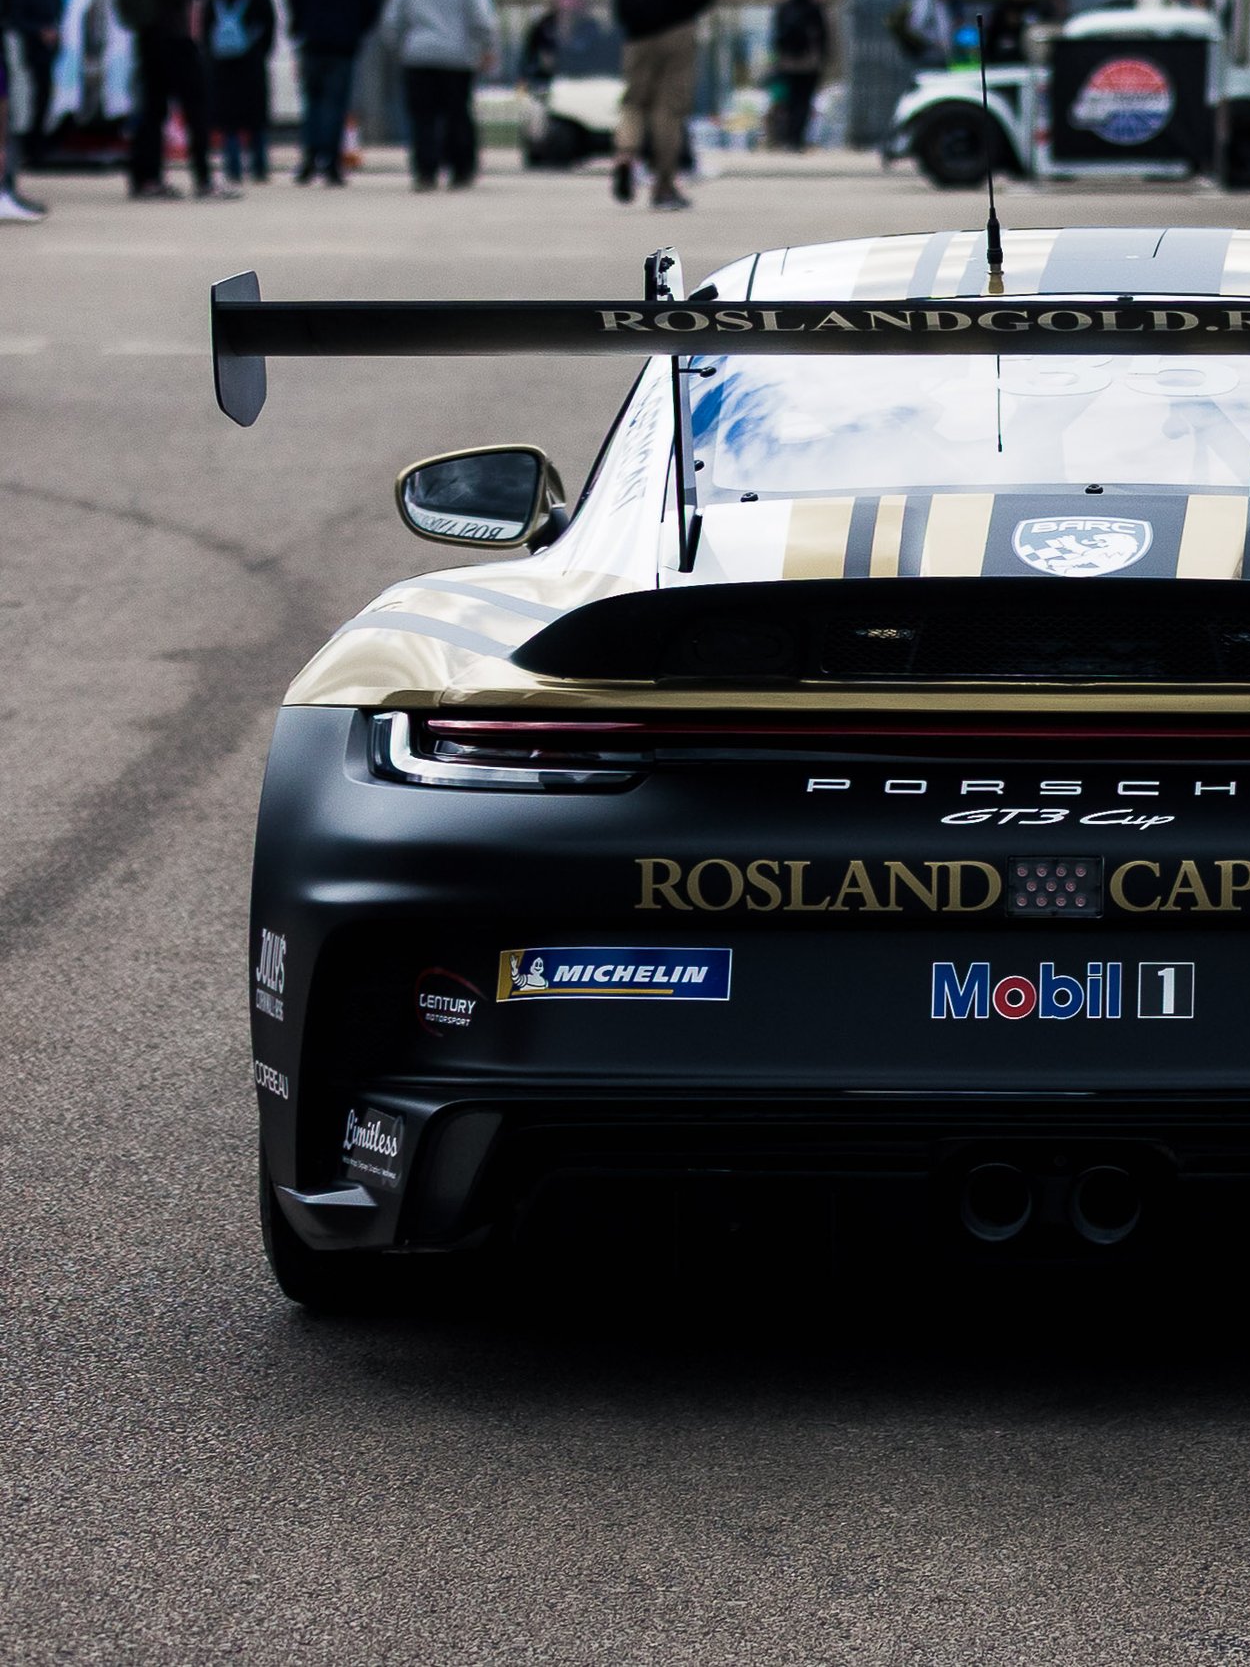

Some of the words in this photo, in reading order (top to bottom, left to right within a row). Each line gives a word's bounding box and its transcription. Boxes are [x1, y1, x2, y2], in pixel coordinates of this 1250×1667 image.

[1031, 520, 1137, 533] BARC
[941, 808, 1070, 825] GT3
[1080, 809, 1175, 830] Cup
[634, 858, 1001, 912] ROSLAND
[553, 964, 709, 983] MICHELIN
[931, 962, 1122, 1019] Mobil
[419, 993, 476, 1015] CENTURY
[343, 1109, 398, 1157] Limitless
